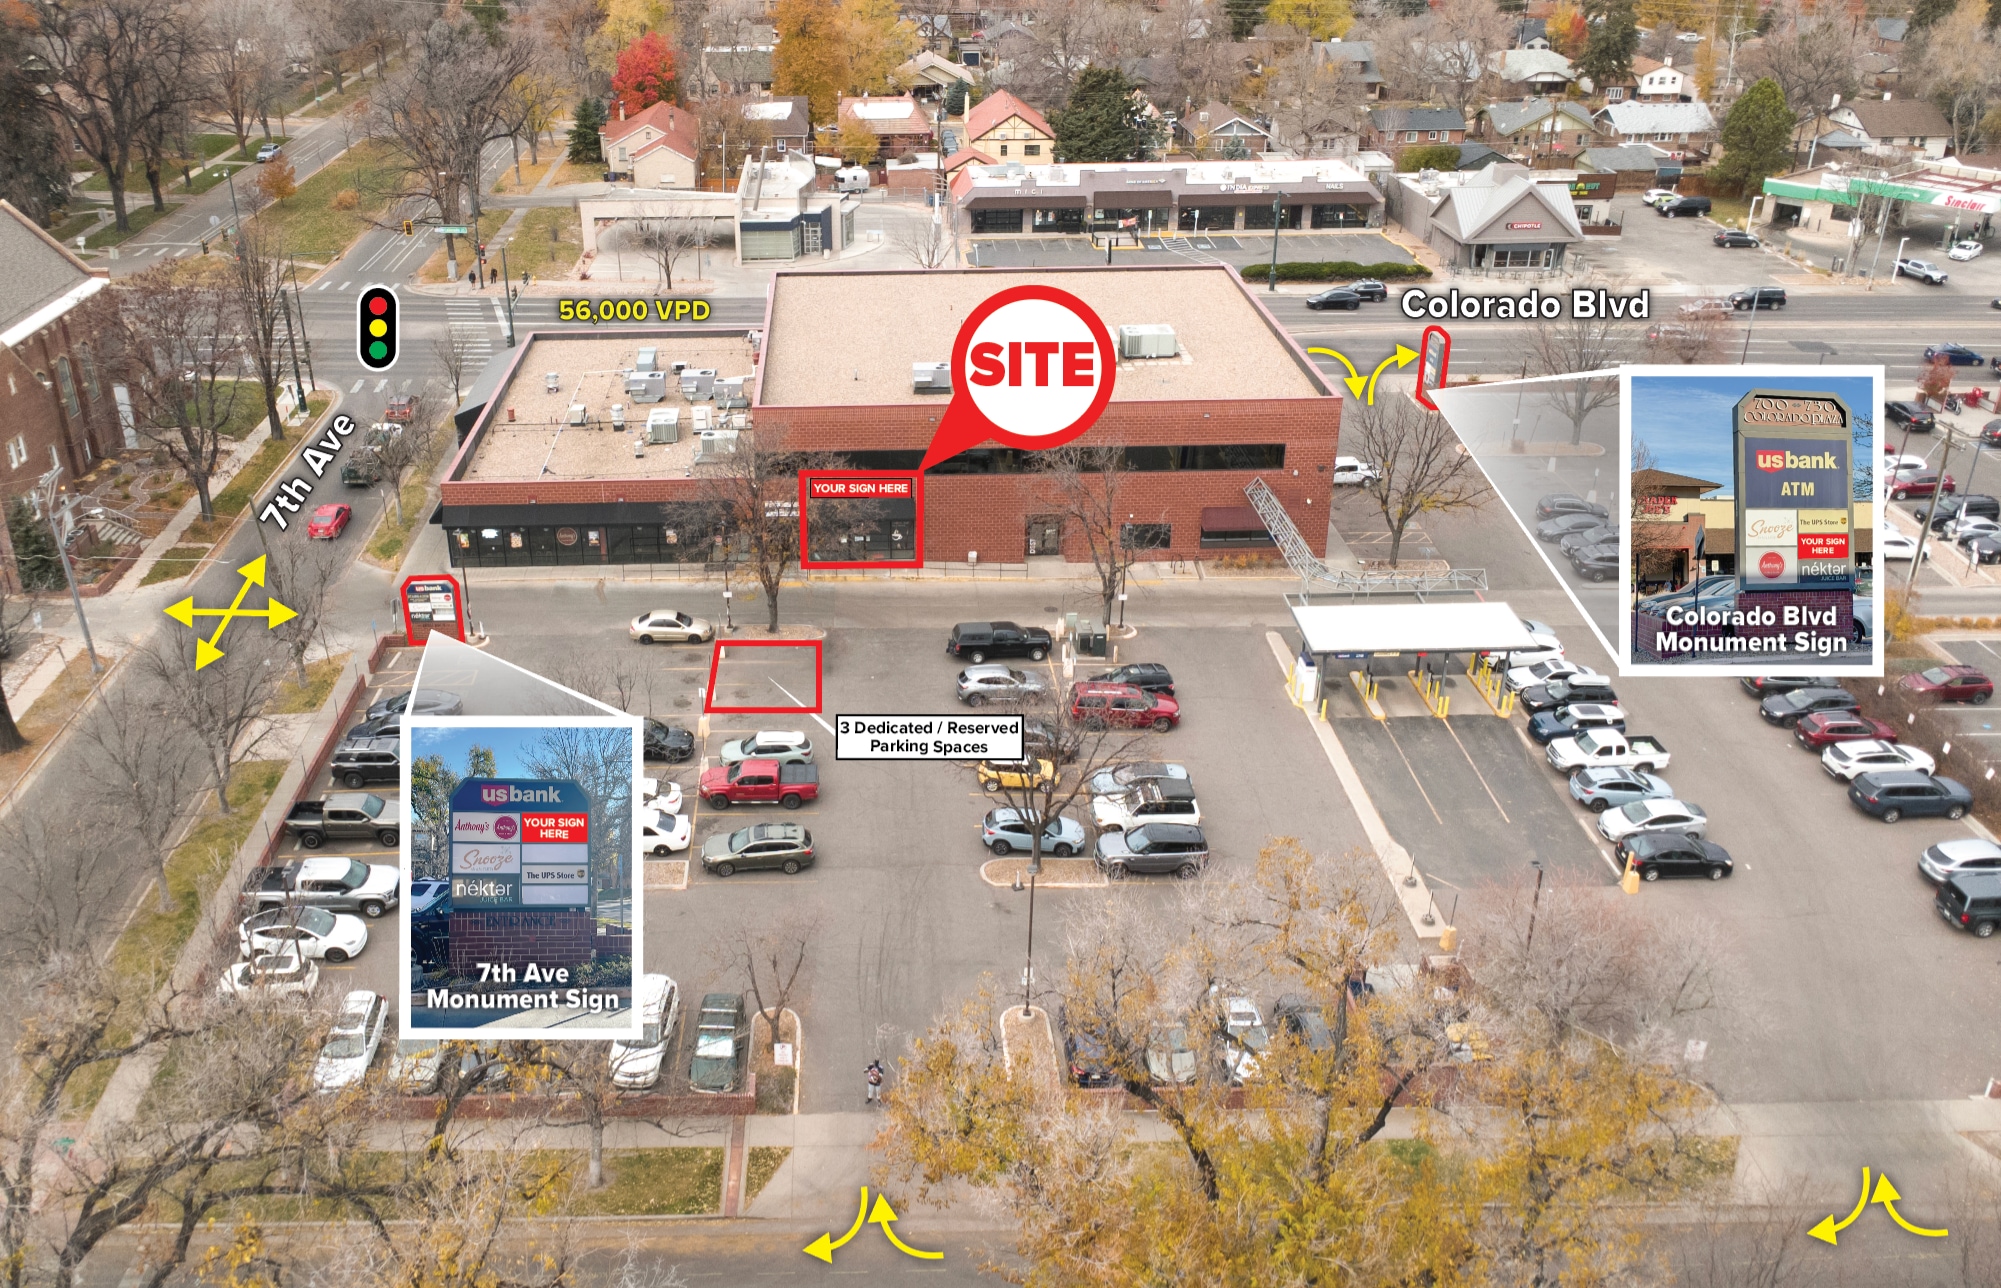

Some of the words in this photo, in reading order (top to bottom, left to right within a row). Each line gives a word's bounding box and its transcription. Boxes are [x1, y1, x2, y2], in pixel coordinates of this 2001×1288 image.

[1325, 183, 1344, 191] NAILS
[1944, 195, 1987, 212] Sinclair
[1753, 397, 1789, 411] 700
[1781, 481, 1815, 496] ATM
[1748, 519, 1793, 539] Snooze
[455, 819, 489, 834] Anthony's
[460, 849, 513, 871] Snooze
[486, 915, 556, 927] ENTRANCE
